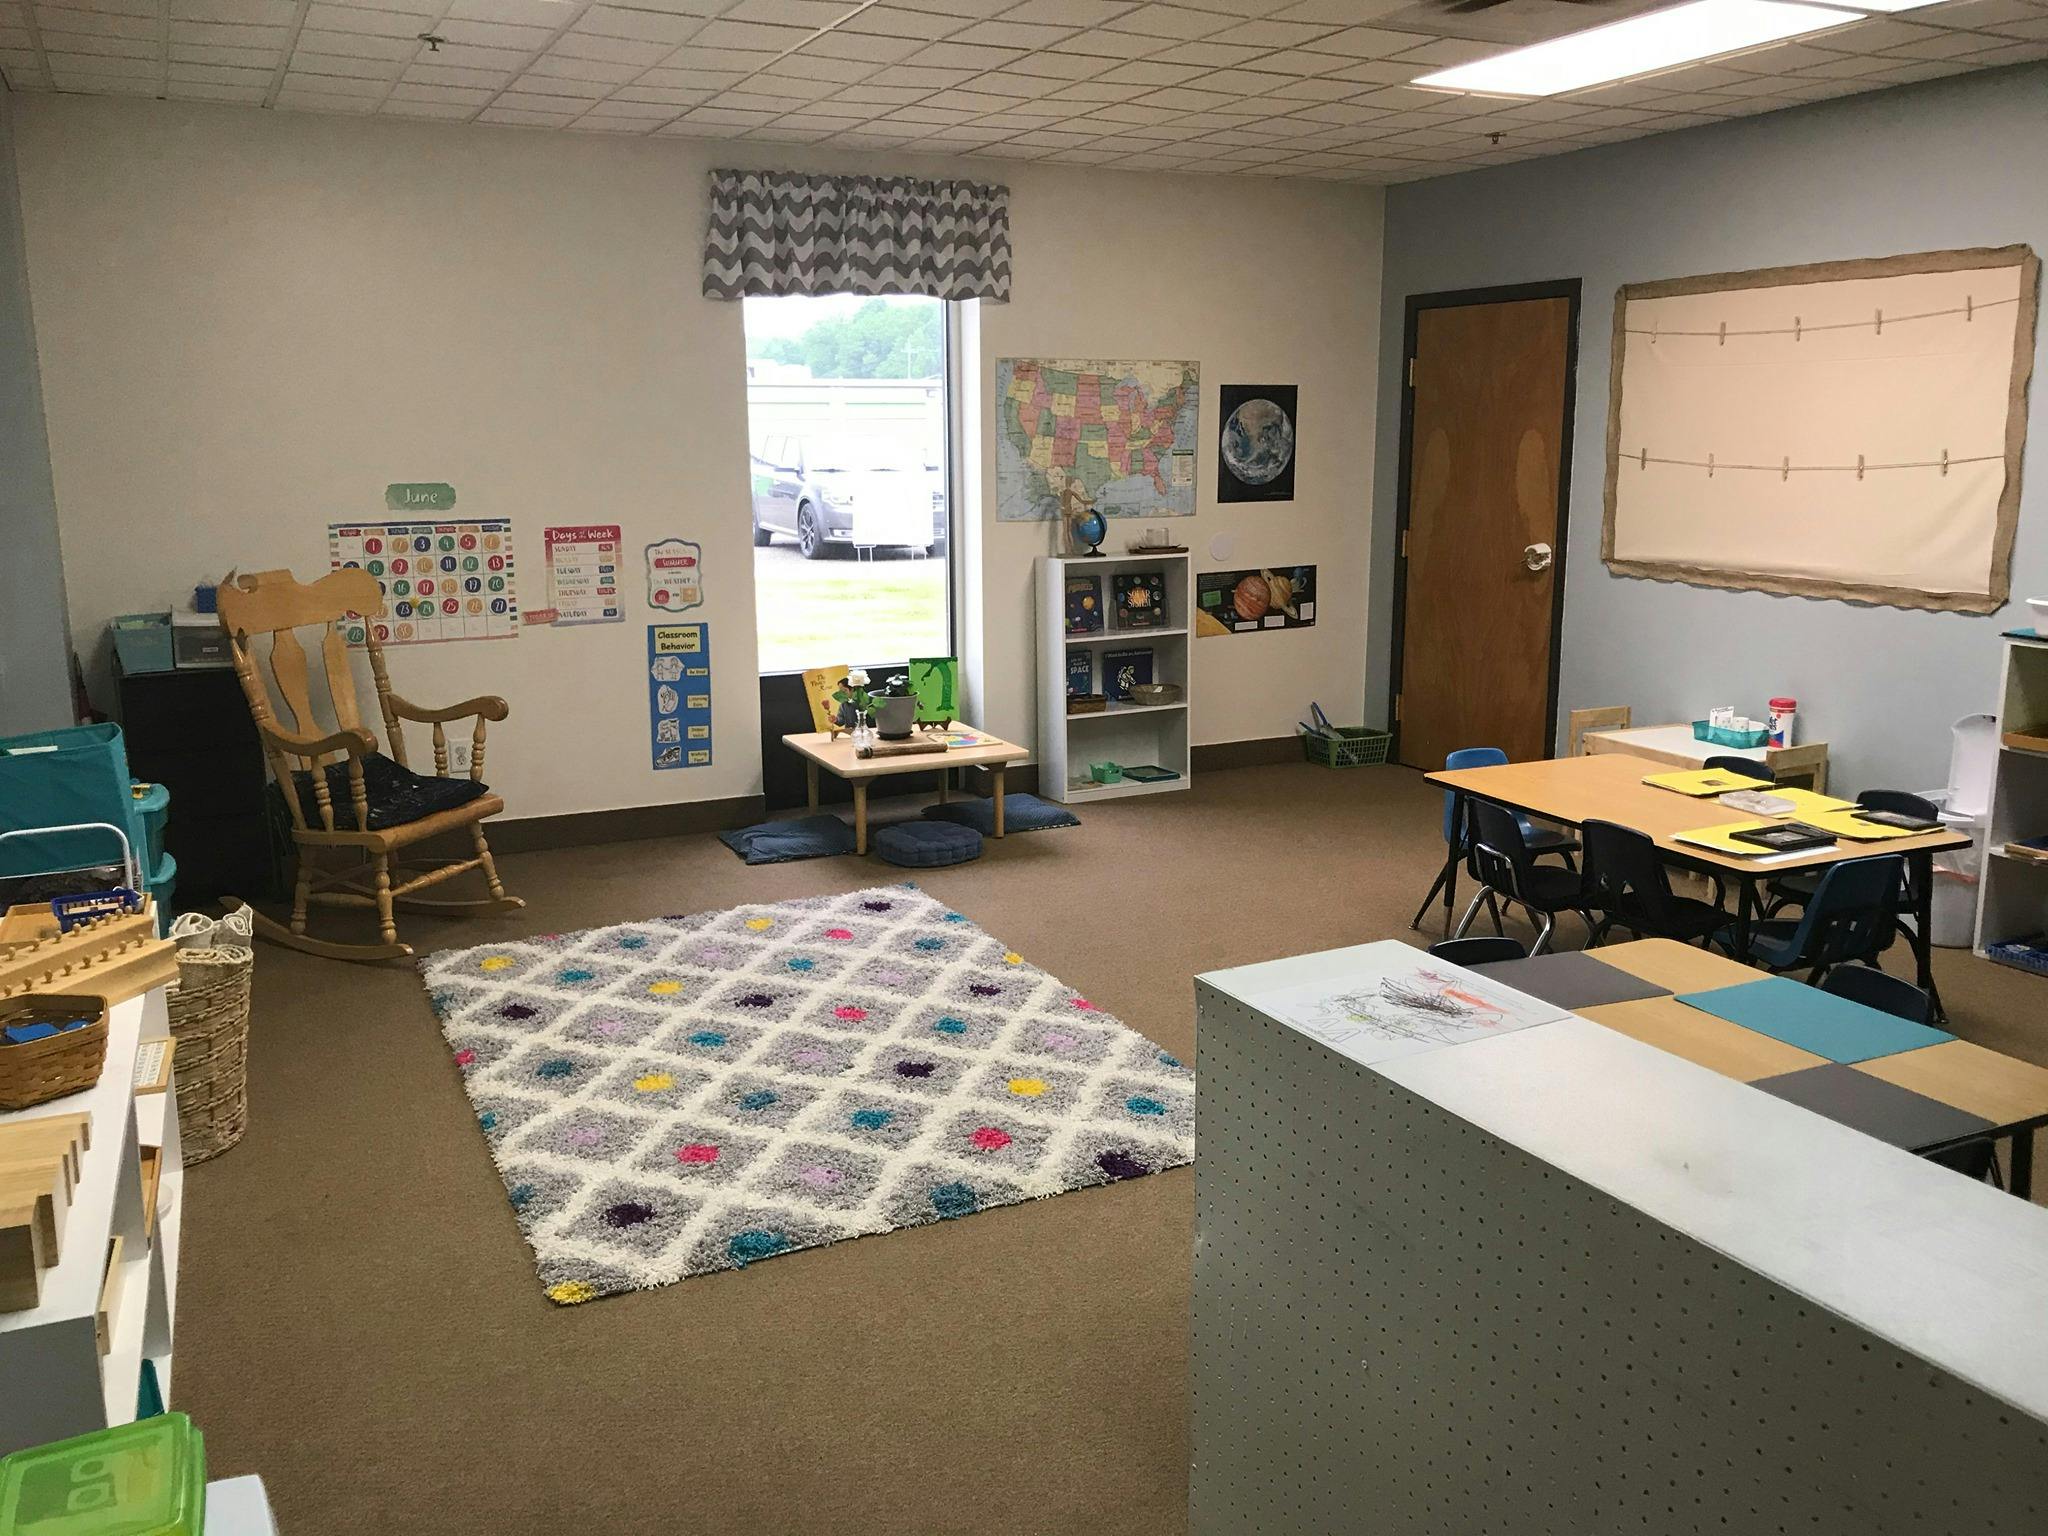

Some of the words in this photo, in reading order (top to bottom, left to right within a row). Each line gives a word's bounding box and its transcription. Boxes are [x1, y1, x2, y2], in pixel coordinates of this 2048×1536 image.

[404, 488, 438, 504] June
[552, 529, 577, 541] Days
[587, 528, 614, 540] Week
[420, 540, 426, 549] 3
[443, 539, 450, 549] 4
[464, 536, 471, 547] 5
[397, 563, 404, 573] 9
[445, 559, 452, 569] 11
[466, 559, 474, 569] 12
[491, 558, 501, 569] 13
[662, 559, 689, 567] SUMMER
[556, 567, 581, 575] TUESDAY
[396, 583, 406, 593] 16
[421, 583, 431, 593] 17
[469, 580, 478, 590] 19
[491, 580, 501, 589] 20
[557, 588, 587, 597] THURSDAY
[1127, 589, 1151, 599] SOLAR
[400, 604, 410, 615] 23
[422, 603, 432, 613] 24
[446, 600, 457, 611] 25
[495, 600, 504, 611] 27
[1127, 599, 1152, 608] SYSTEM
[559, 610, 587, 618] SATURDAY
[350, 630, 361, 640] 28
[400, 626, 410, 637] 30
[657, 631, 698, 640] Classroom
[660, 642, 696, 651] Behavior
[1070, 665, 1090, 675] SPACE
